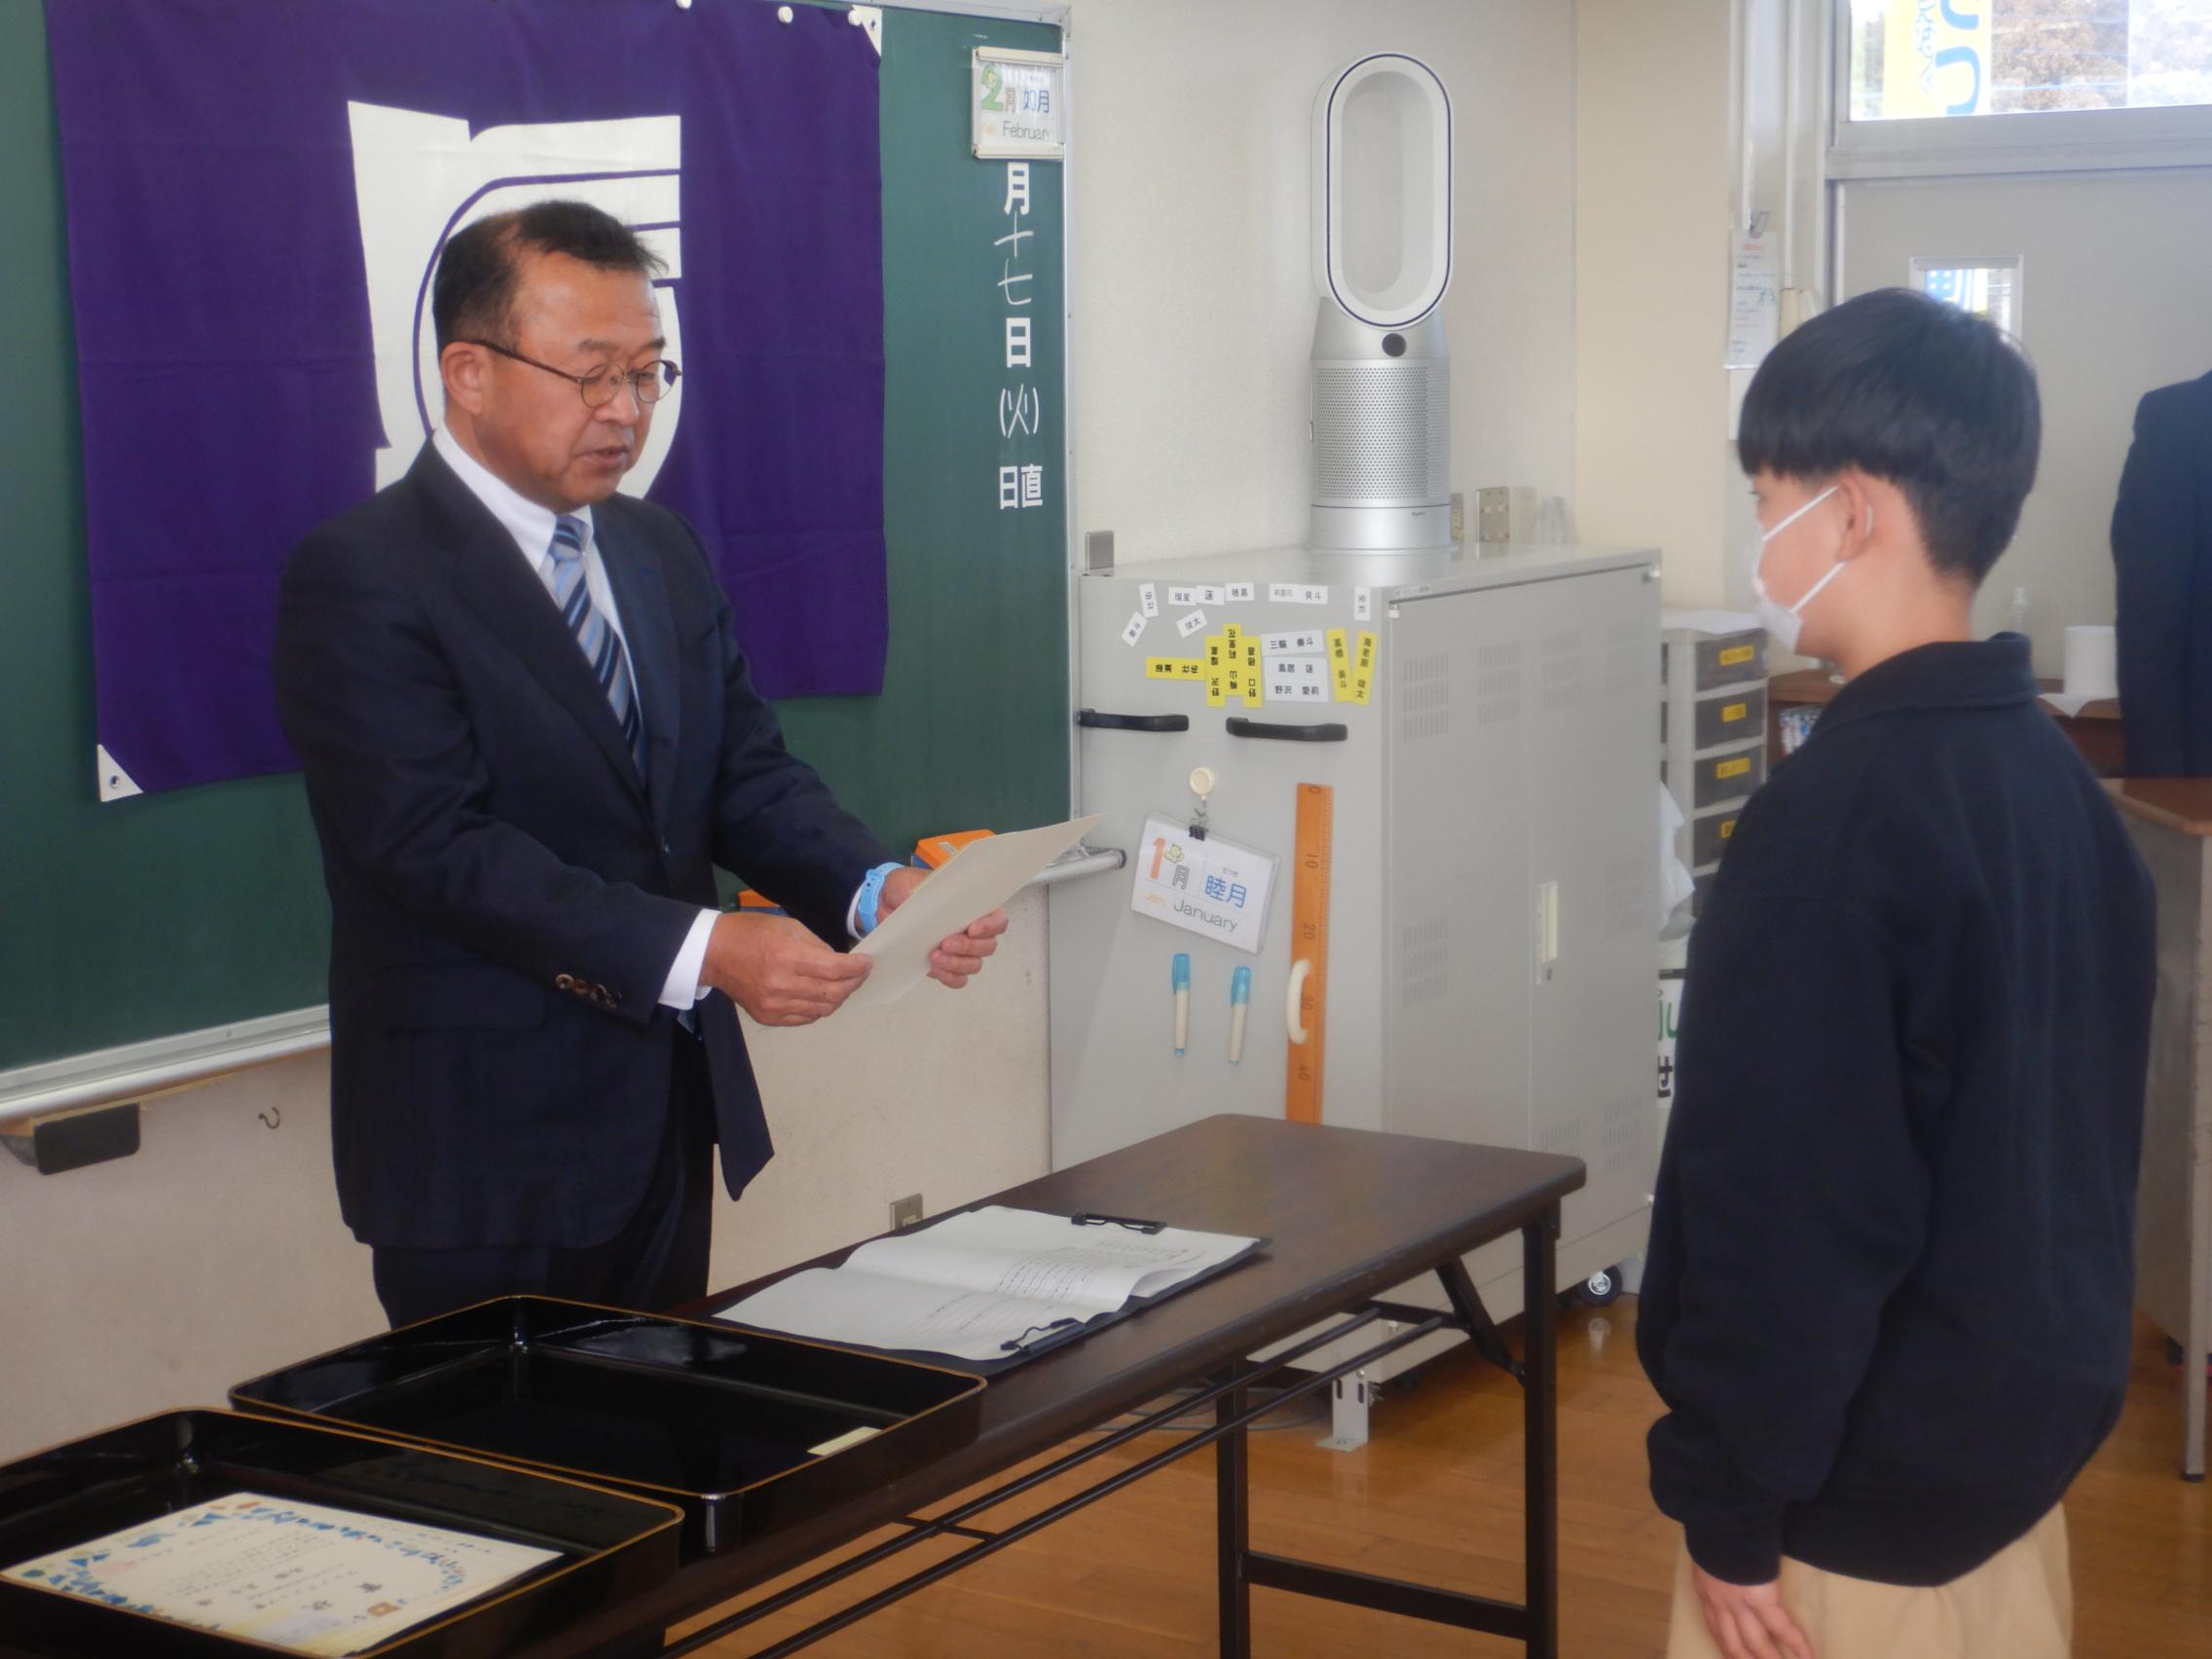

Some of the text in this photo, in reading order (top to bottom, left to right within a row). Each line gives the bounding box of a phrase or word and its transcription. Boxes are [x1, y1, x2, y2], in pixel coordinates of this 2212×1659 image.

[1023, 89, 1050, 114] 如月
[1003, 120, 1052, 141] February
[1000, 463, 1043, 509] 日直
[1203, 875, 1247, 908] 睦月
[1173, 899, 1238, 933] January
